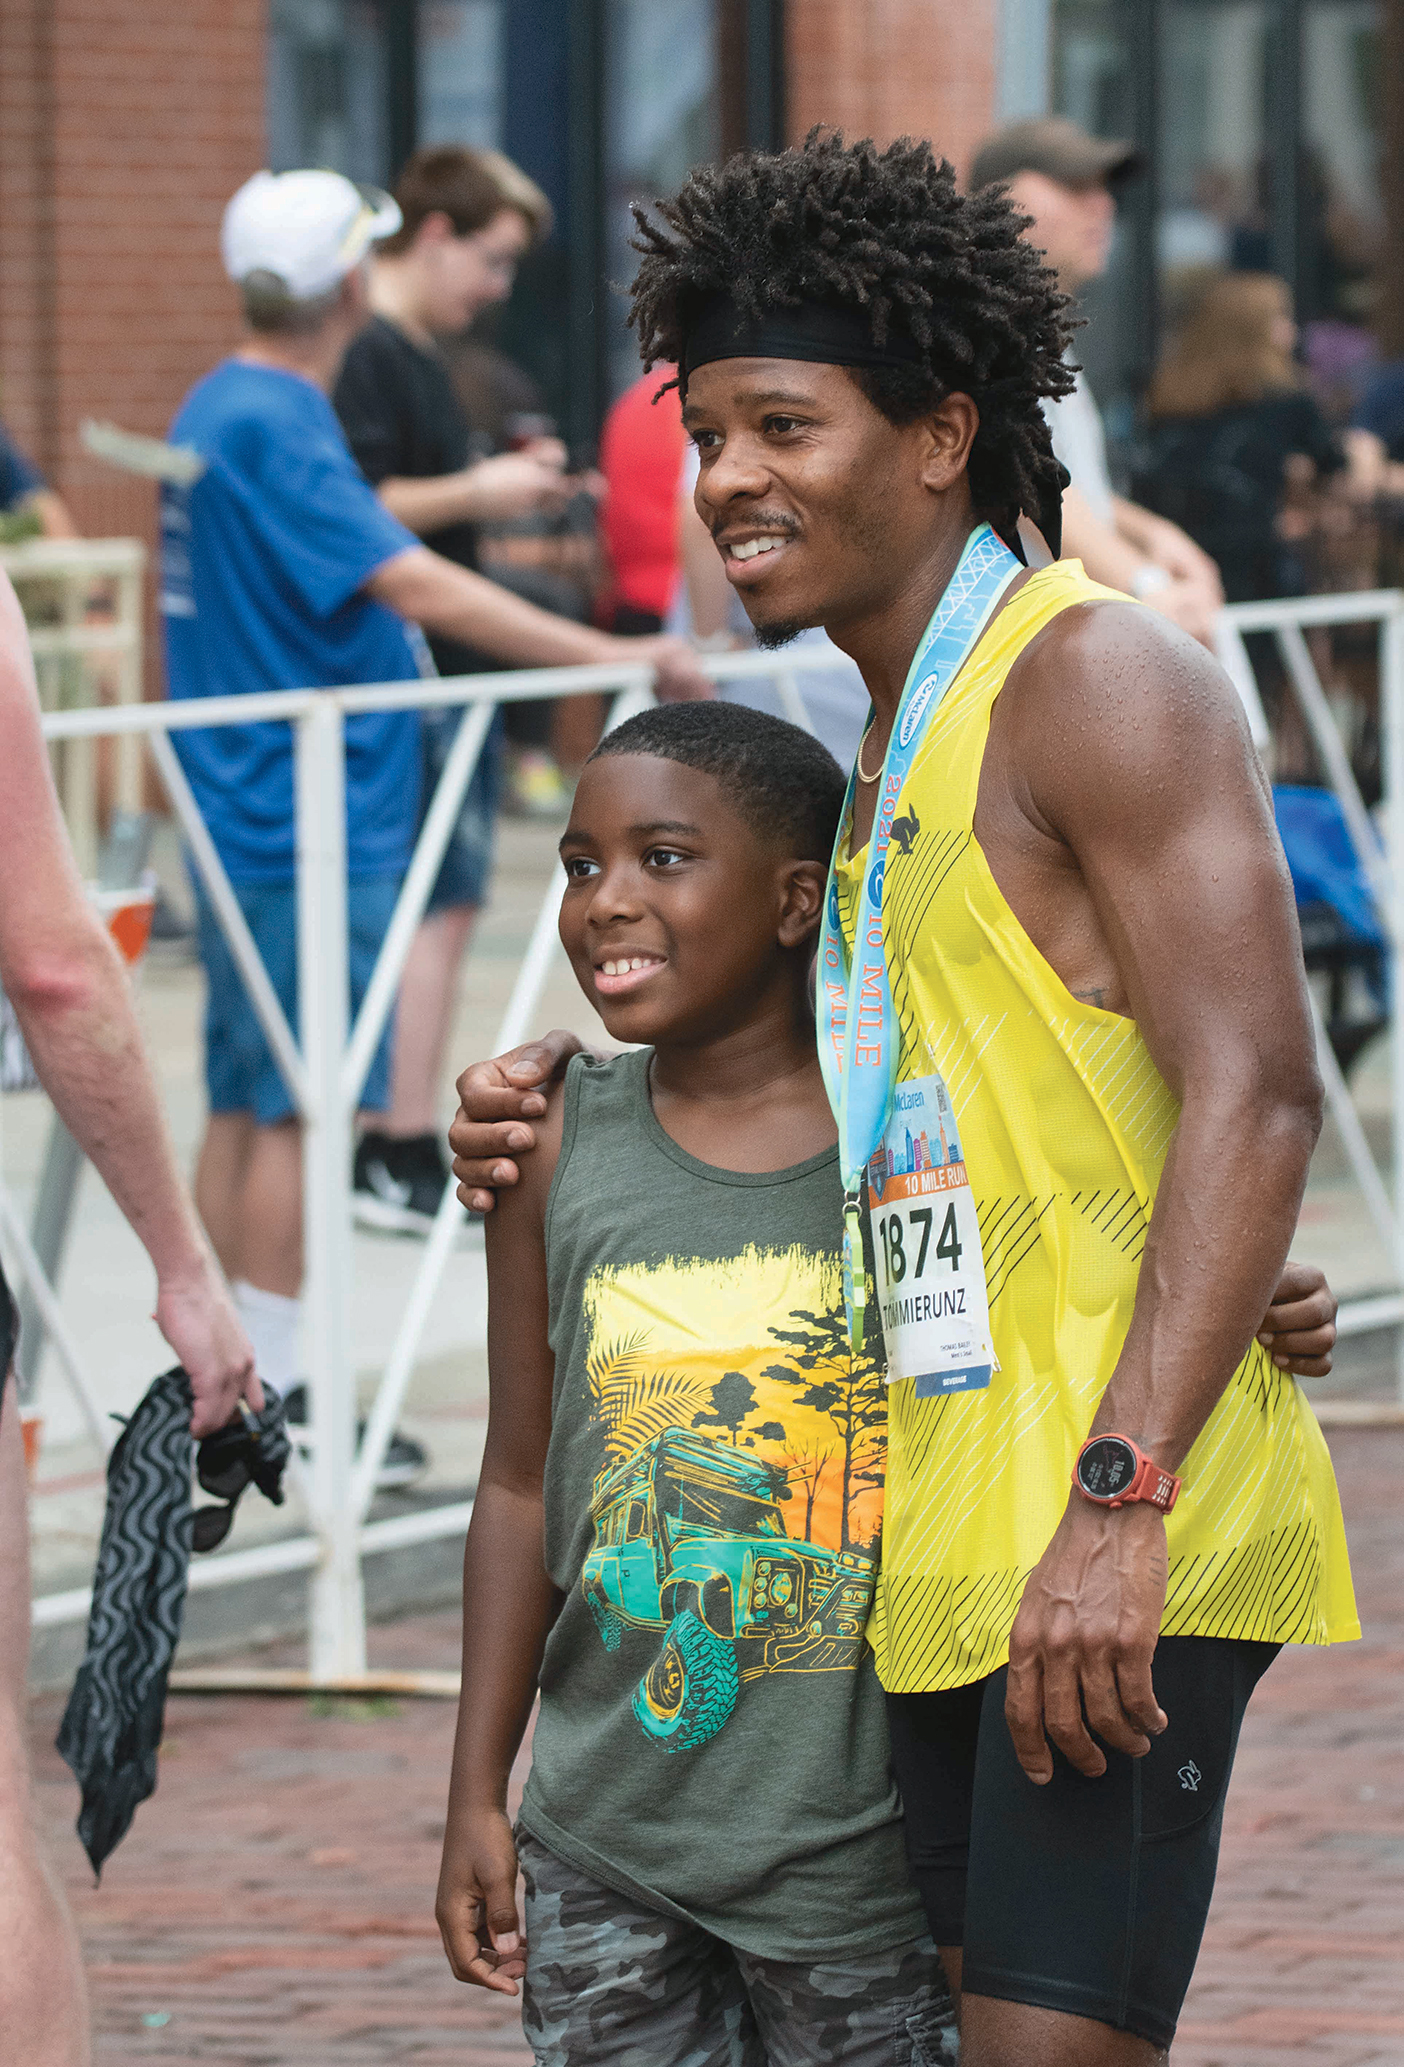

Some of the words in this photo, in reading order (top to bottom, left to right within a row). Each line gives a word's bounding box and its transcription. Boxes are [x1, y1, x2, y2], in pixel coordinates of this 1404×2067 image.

[902, 695, 925, 741] McLaren
[877, 775, 901, 854] 2021
[825, 933, 839, 968] 10
[866, 913, 884, 948] 10
[855, 963, 883, 1067] MILE
[894, 1091, 925, 1112] McLaren
[905, 1175, 919, 1195] 10
[921, 1169, 946, 1192] MILE
[947, 1164, 967, 1187] RUN
[879, 1202, 962, 1287] 1874
[883, 1288, 966, 1331] TOMMIERUNZ
